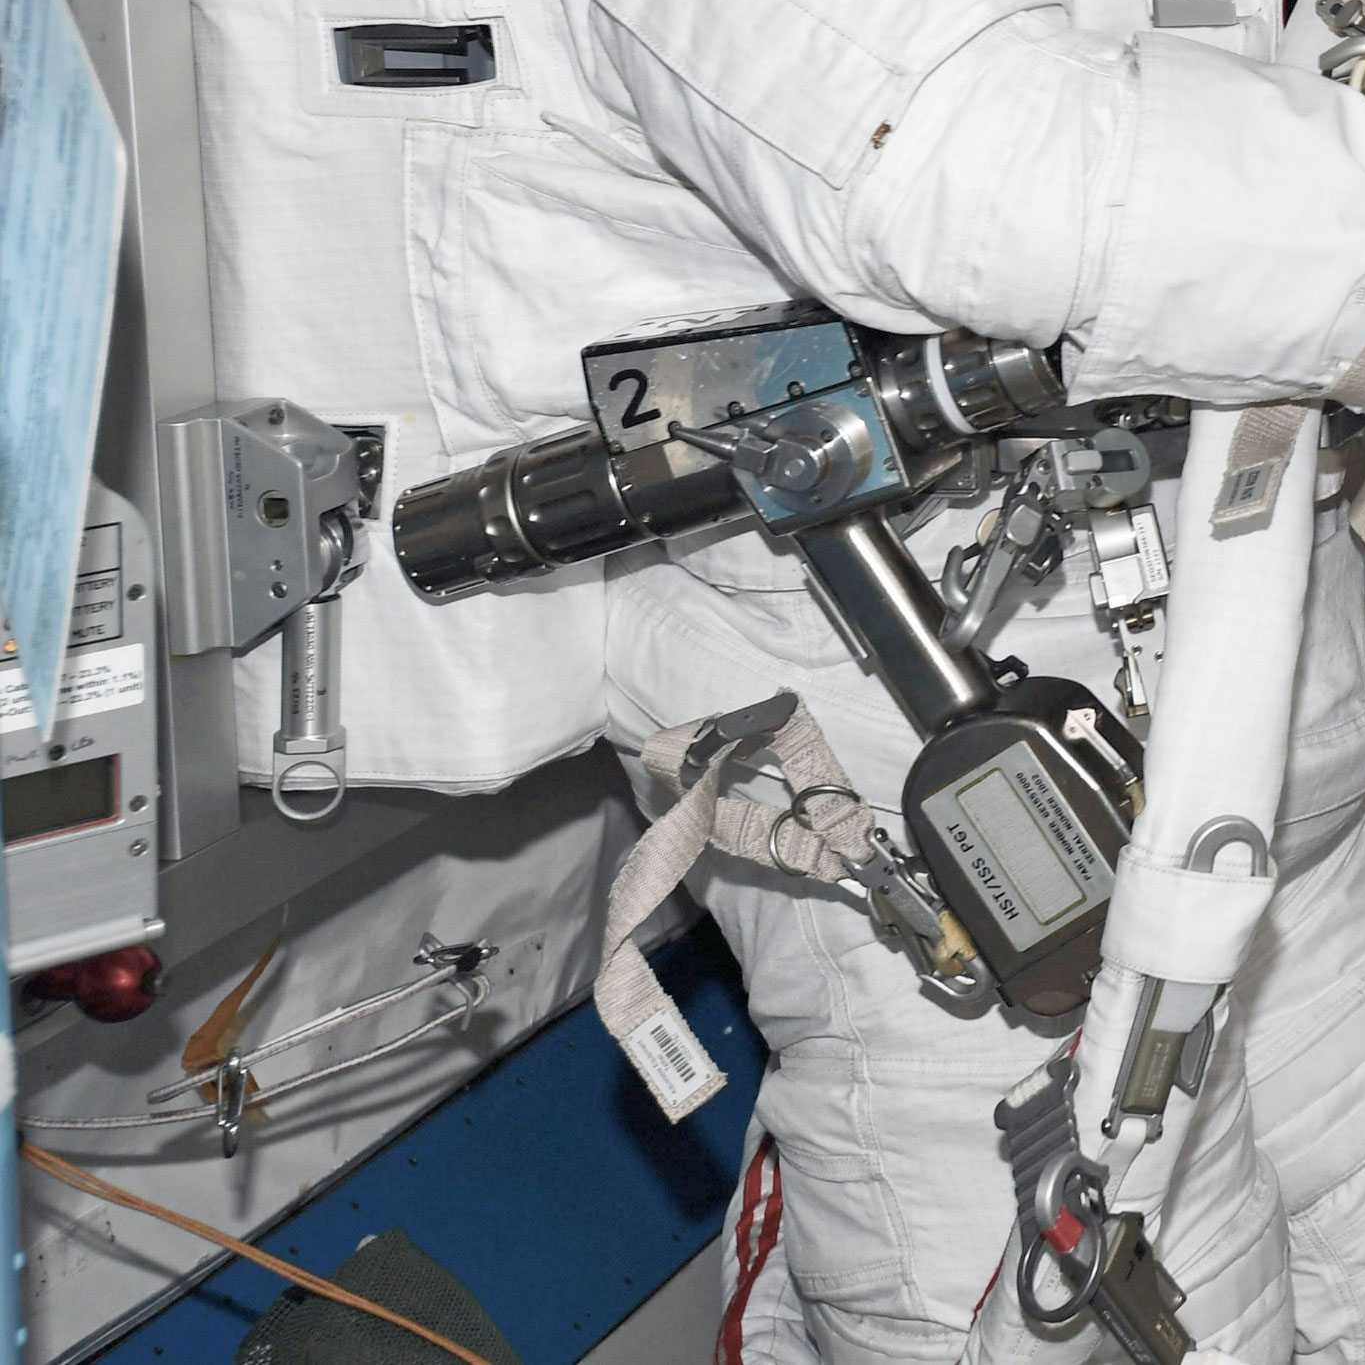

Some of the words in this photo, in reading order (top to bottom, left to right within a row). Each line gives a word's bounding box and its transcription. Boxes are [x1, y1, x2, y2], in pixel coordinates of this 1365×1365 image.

[608, 368, 662, 429] 2
[1030, 771, 1049, 794] 1002
[1046, 795, 1073, 831] NUMBER
[945, 818, 975, 854] PGT
[1047, 819, 1075, 856] NUMBER
[1070, 831, 1096, 865] SERIAL
[1072, 856, 1092, 882] PART
[969, 854, 1020, 922] HST/ISS
